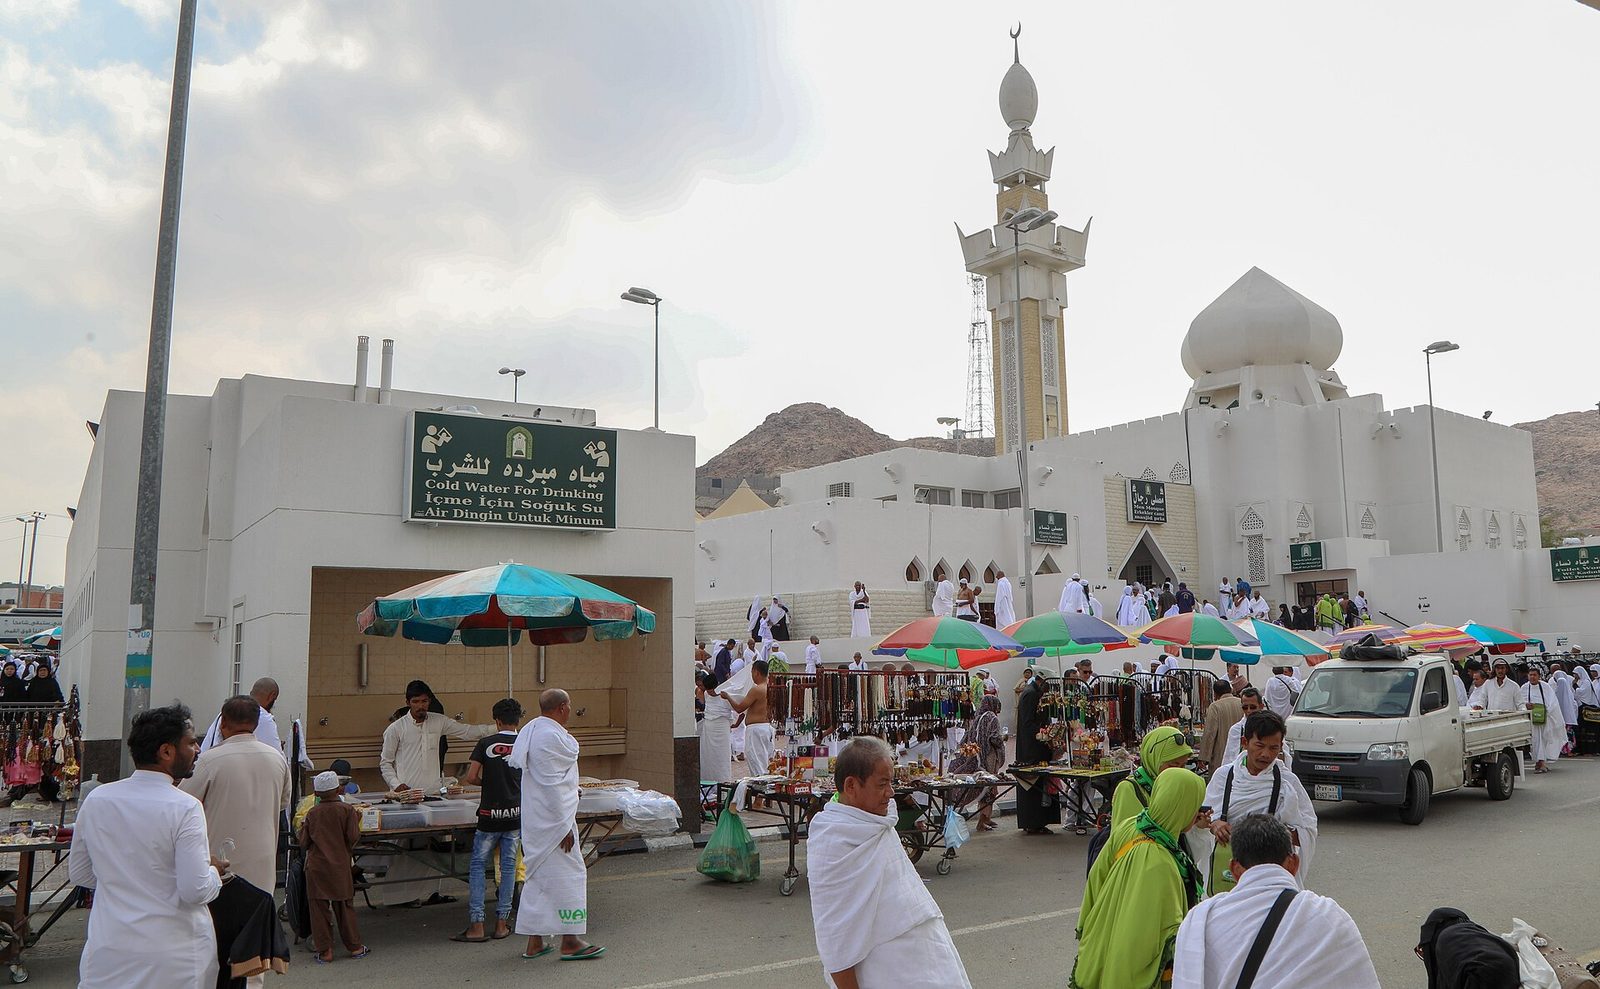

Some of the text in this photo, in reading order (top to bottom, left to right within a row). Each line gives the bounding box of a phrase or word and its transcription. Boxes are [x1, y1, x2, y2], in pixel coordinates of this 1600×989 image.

[426, 453, 605, 488] مياه مبرده للشرب
[425, 479, 604, 501] Cold Water For Drinking
[425, 491, 604, 513] İçme İçin Soğuk Su
[424, 507, 449, 517] Air
[452, 508, 502, 522] Dingin
[507, 511, 551, 523] Untuk
[556, 515, 604, 526] Minum
